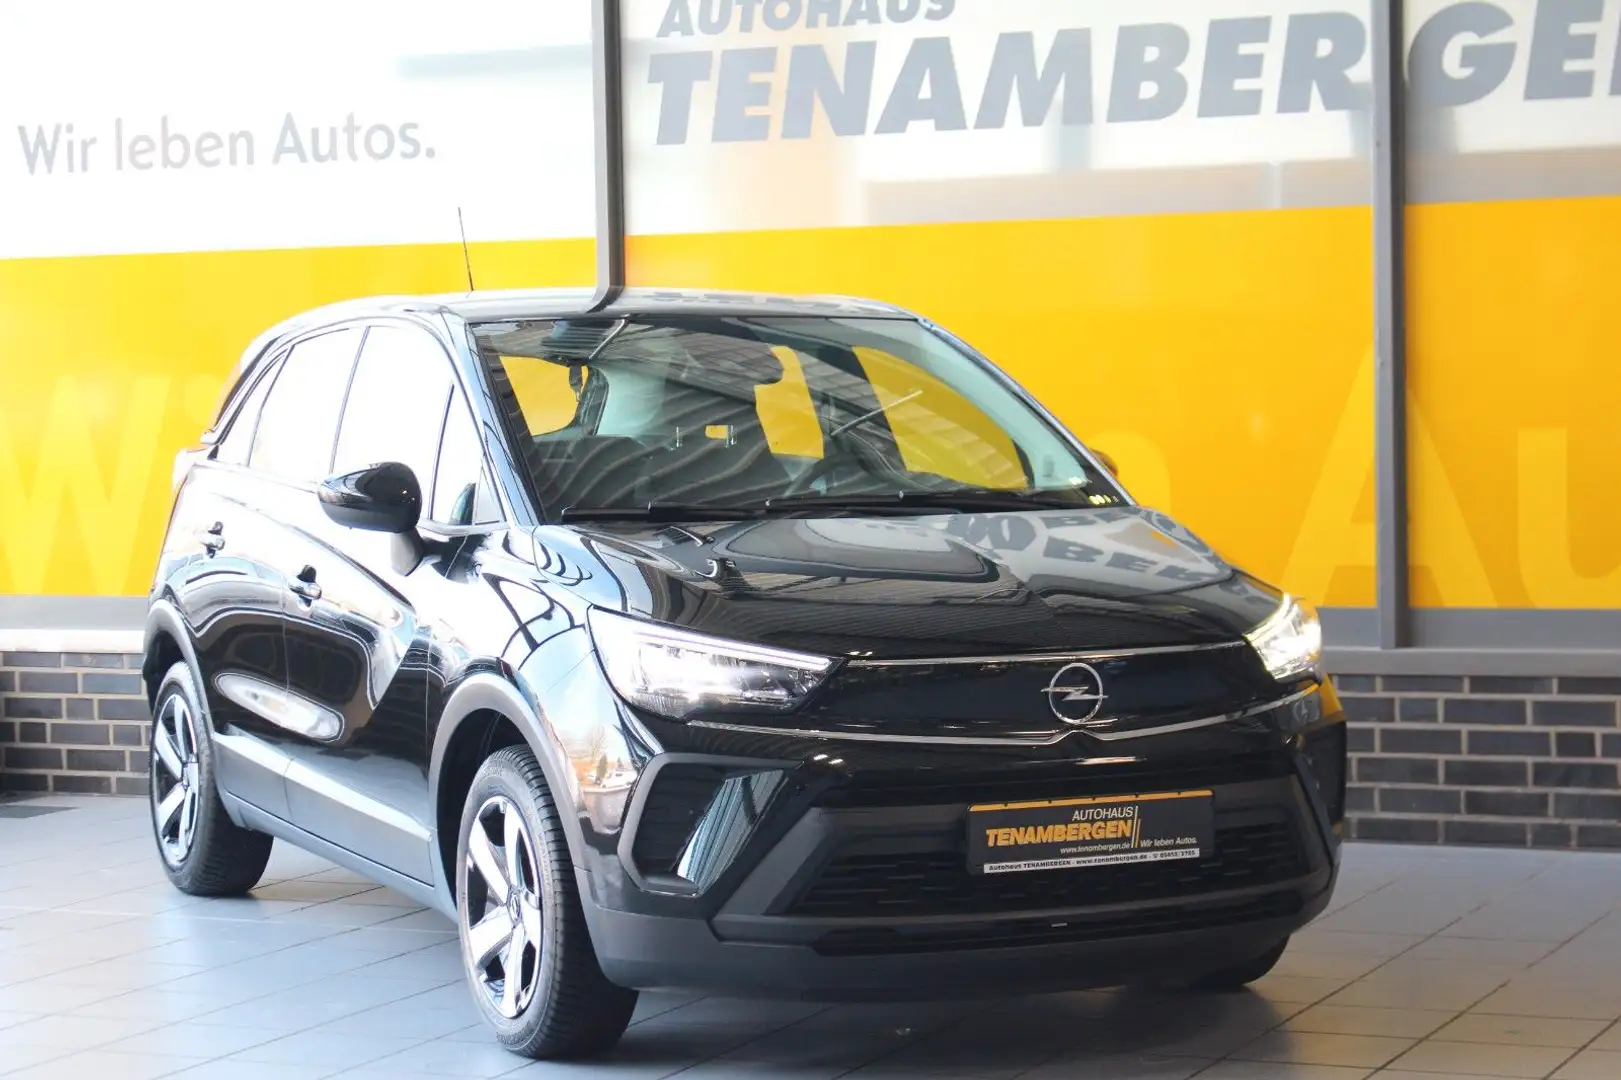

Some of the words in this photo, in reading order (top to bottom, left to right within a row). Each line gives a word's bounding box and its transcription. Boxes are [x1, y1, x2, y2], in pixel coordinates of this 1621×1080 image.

[656, 0, 957, 38] AUTOHAUS
[647, 0, 1621, 145] TENAMBERGE
[17, 122, 98, 175] Wir
[114, 114, 255, 170] leben
[272, 111, 436, 165] Autos.
[1072, 806, 1133, 821] AUTOHAUS
[986, 819, 1132, 847] TENAMBERGEN
[1140, 839, 1153, 848] Wir
[1154, 837, 1174, 847] leben
[1060, 842, 1130, 854] www.tenambergen.de
[989, 863, 1022, 871] Autohaus
[1024, 860, 1071, 869] TENAMBERGEN
